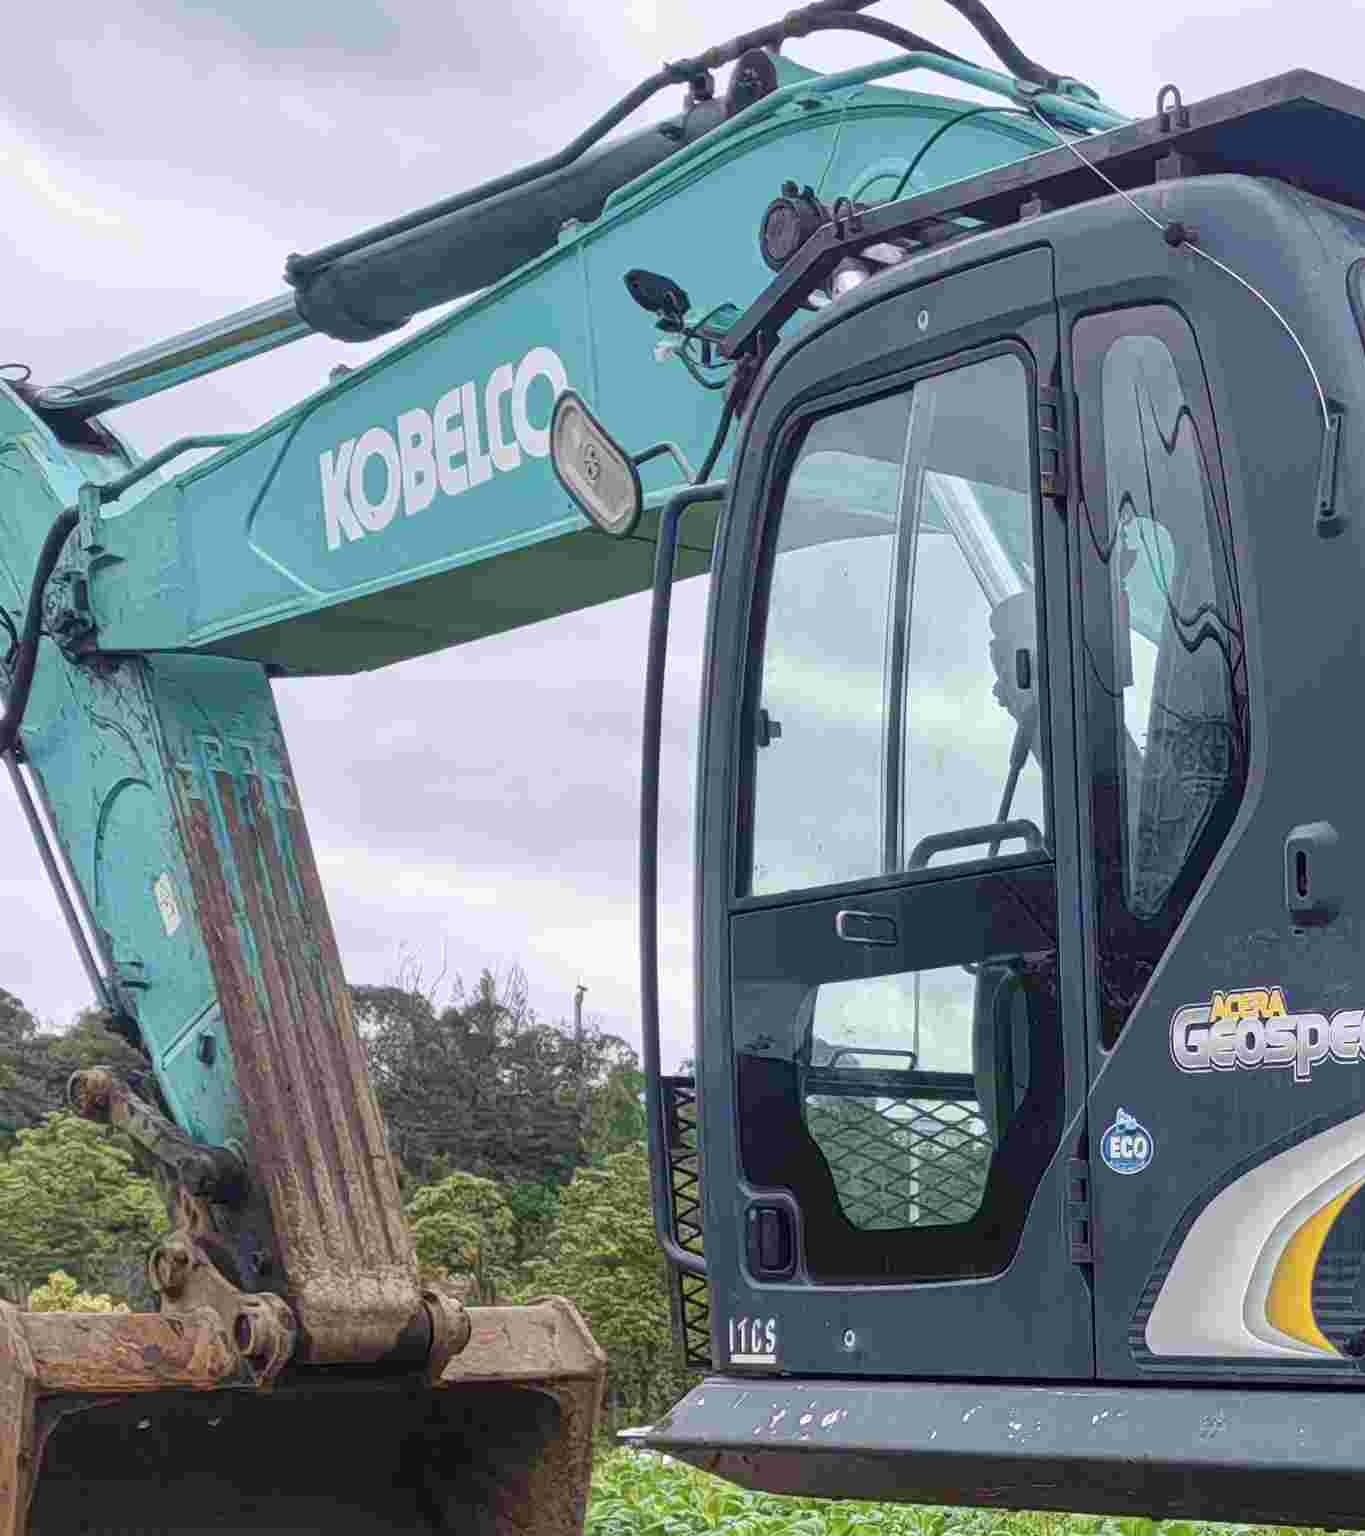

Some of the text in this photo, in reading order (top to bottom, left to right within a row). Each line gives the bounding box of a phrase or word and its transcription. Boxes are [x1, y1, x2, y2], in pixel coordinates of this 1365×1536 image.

[318, 345, 570, 552] KOBELCO
[1209, 988, 1285, 1023] ACERA
[1110, 1135, 1147, 1158] ECO
[729, 1316, 777, 1353] ITCS
